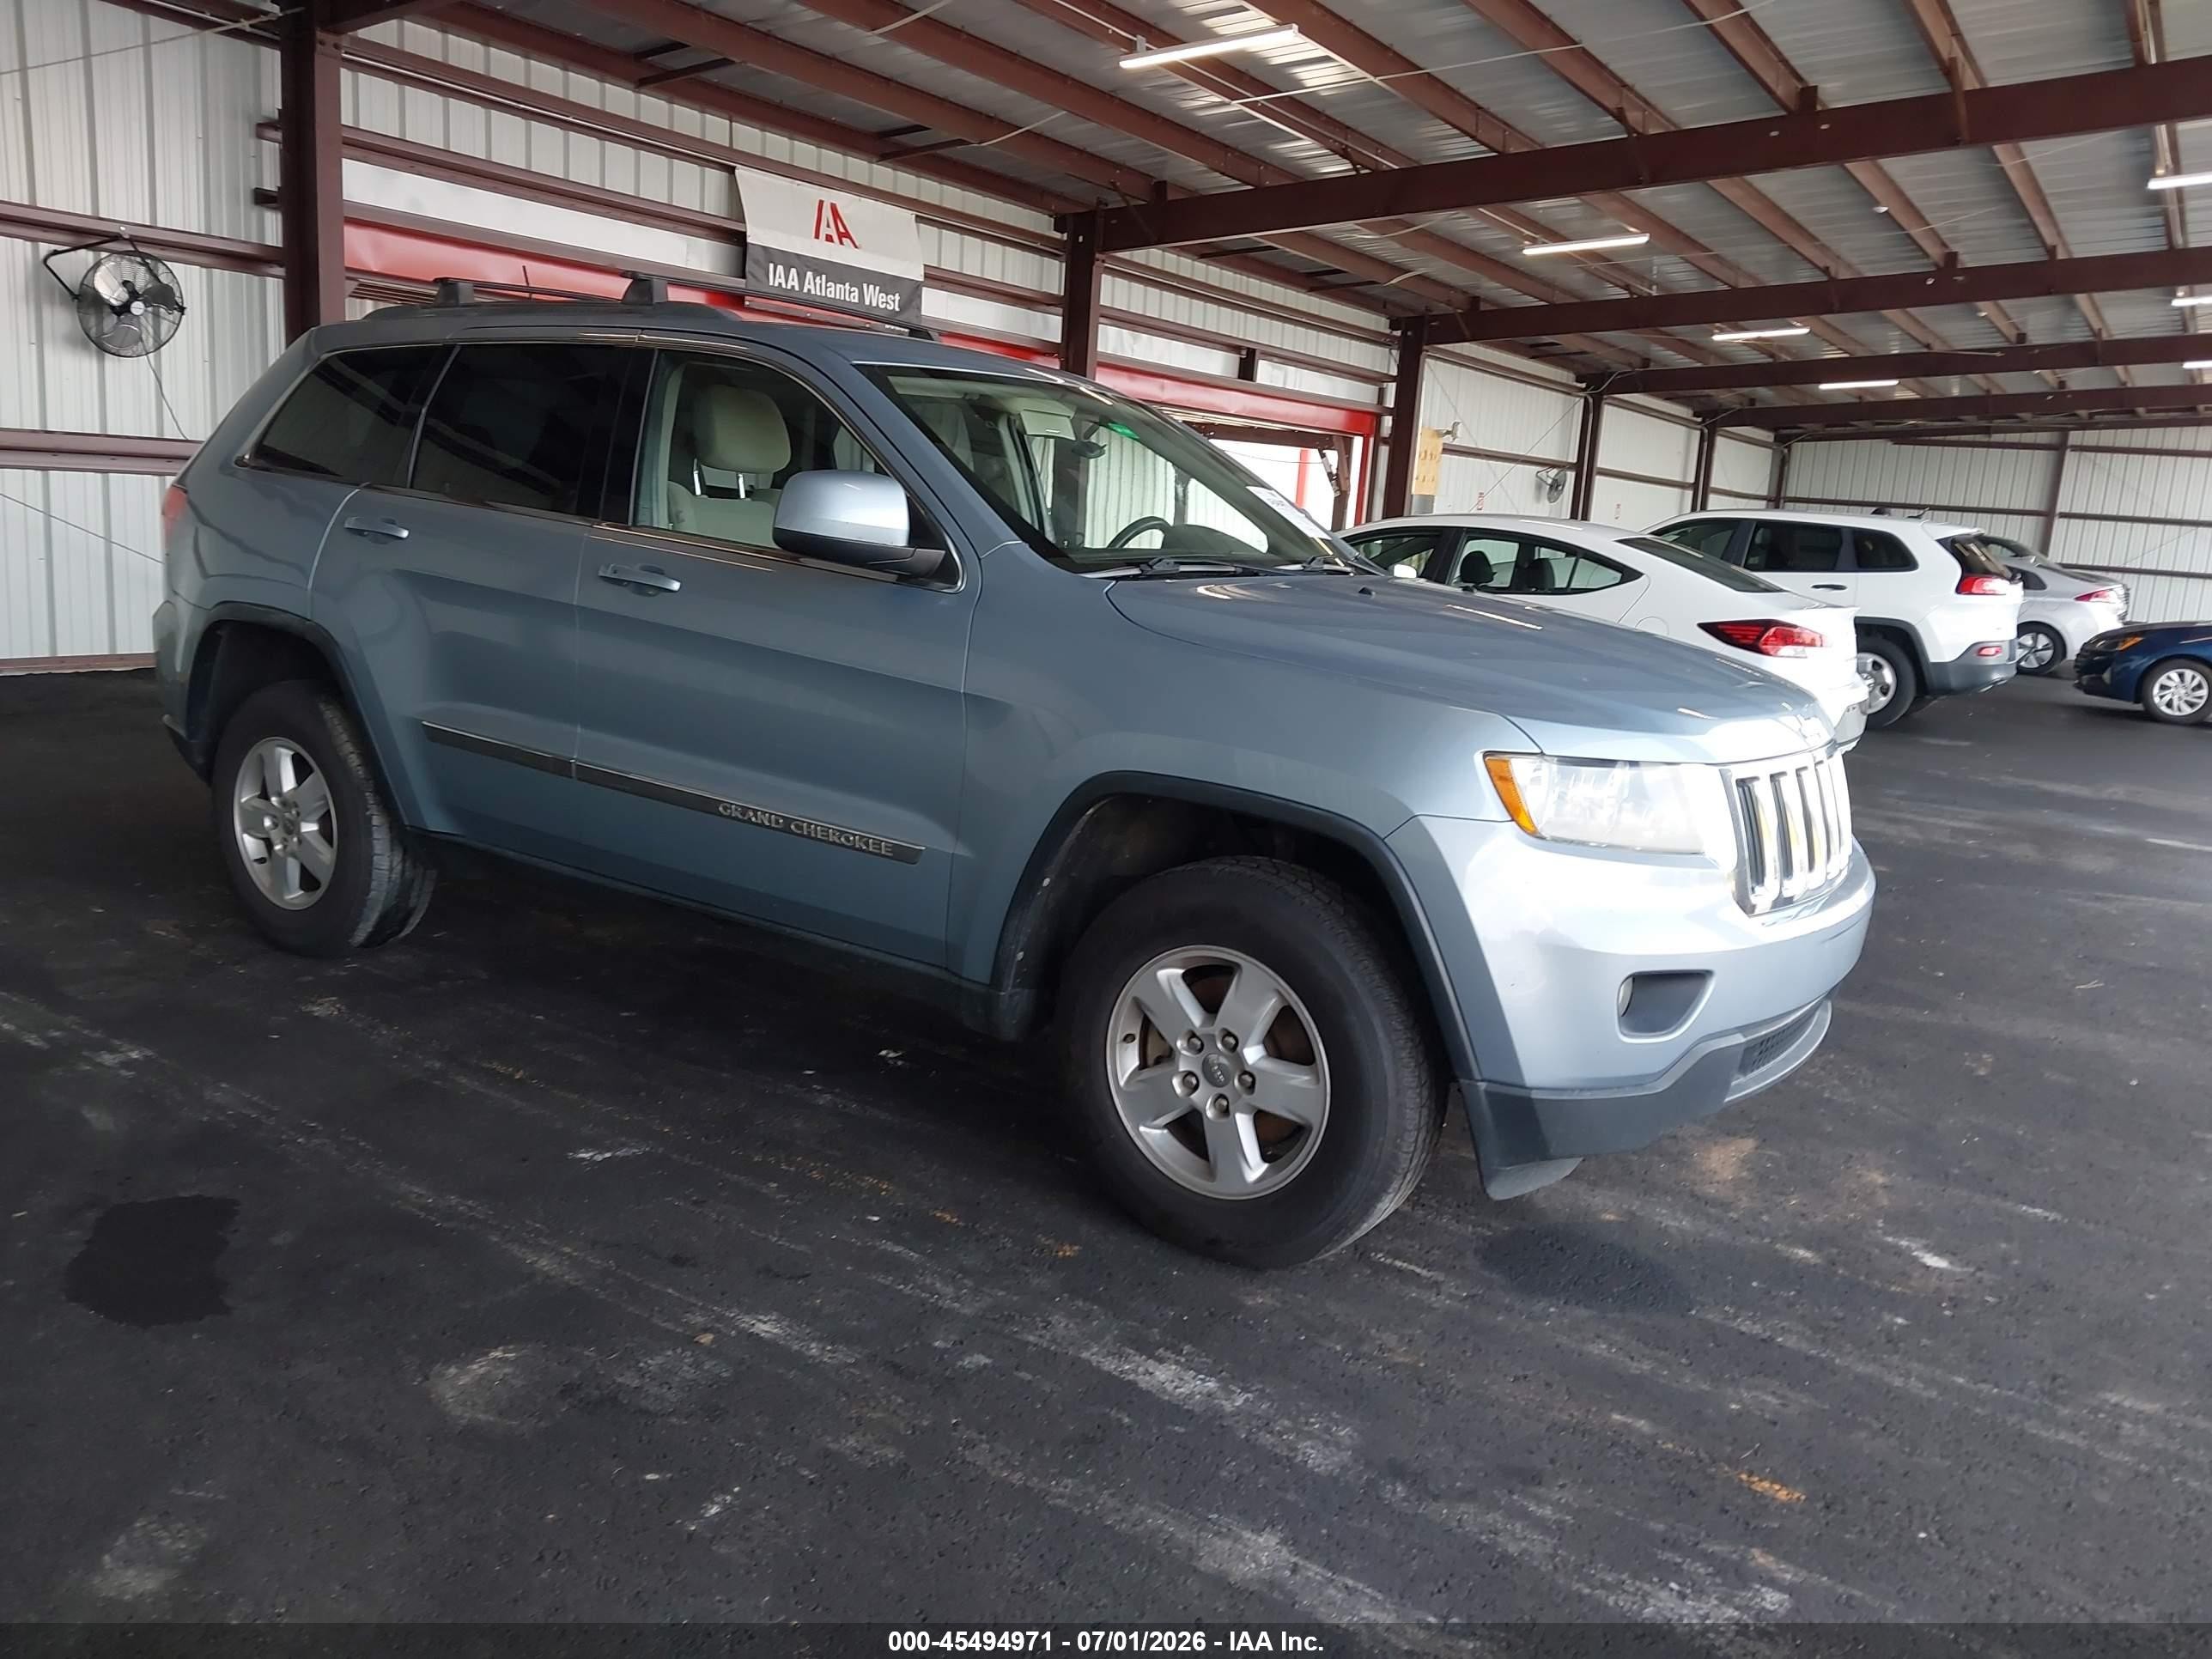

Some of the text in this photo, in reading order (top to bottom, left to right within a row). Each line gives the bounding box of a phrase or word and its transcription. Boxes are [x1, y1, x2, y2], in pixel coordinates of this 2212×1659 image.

[814, 199, 860, 249] IAA
[769, 263, 900, 312] IAA Atlanta West
[718, 803, 894, 856] GRAND CHEROKEE
